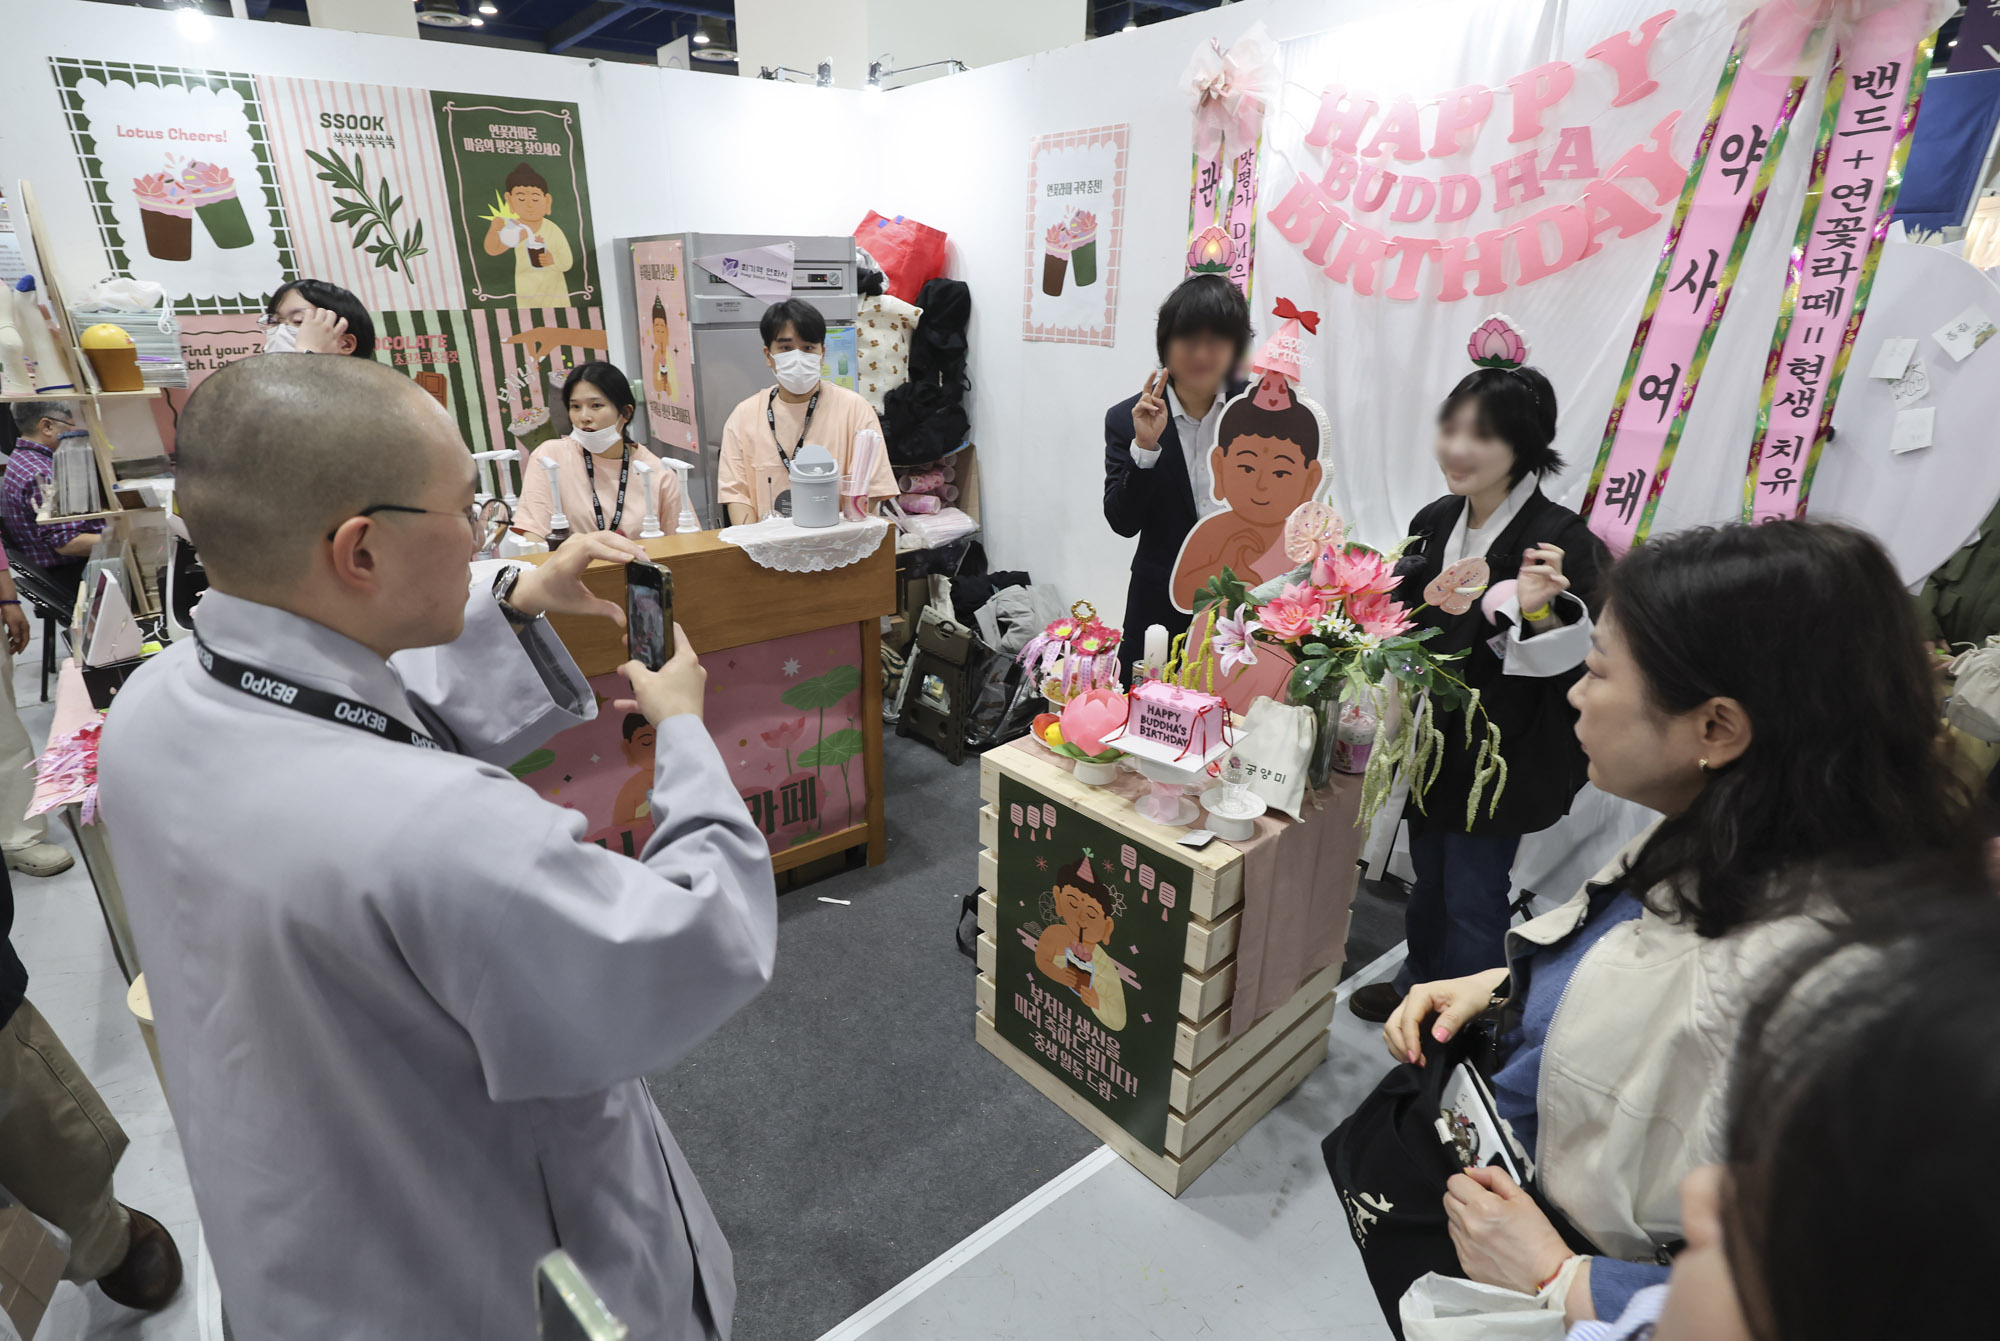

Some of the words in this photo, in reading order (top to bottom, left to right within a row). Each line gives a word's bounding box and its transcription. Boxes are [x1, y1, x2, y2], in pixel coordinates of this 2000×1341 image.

[1305, 9, 1677, 161] HAPPY
[116, 125, 164, 140] Lotus
[168, 127, 228, 143] Cheers!
[320, 112, 384, 131] SSOOK
[463, 138, 495, 153] 마음의
[524, 141, 562, 156] 찾으세요
[1267, 110, 1689, 302] BIRTHDAY
[216, 347, 249, 359] your
[1760, 435, 1804, 496] 치유
[240, 671, 298, 705] BEXPO
[334, 702, 388, 733] BEXPO
[1140, 714, 1187, 736] BUDDHA'S
[1147, 704, 1181, 722] HAPPY
[1139, 725, 1188, 747] BIRTHDAY
[1245, 763, 1287, 785] 공양미
[1030, 982, 1072, 1029] 부처님
[1075, 1014, 1120, 1063] 생신을
[1015, 992, 1041, 1029] 미리
[1044, 1014, 1138, 1098] 축하드립니다!
[1060, 1050, 1083, 1081] 일동
